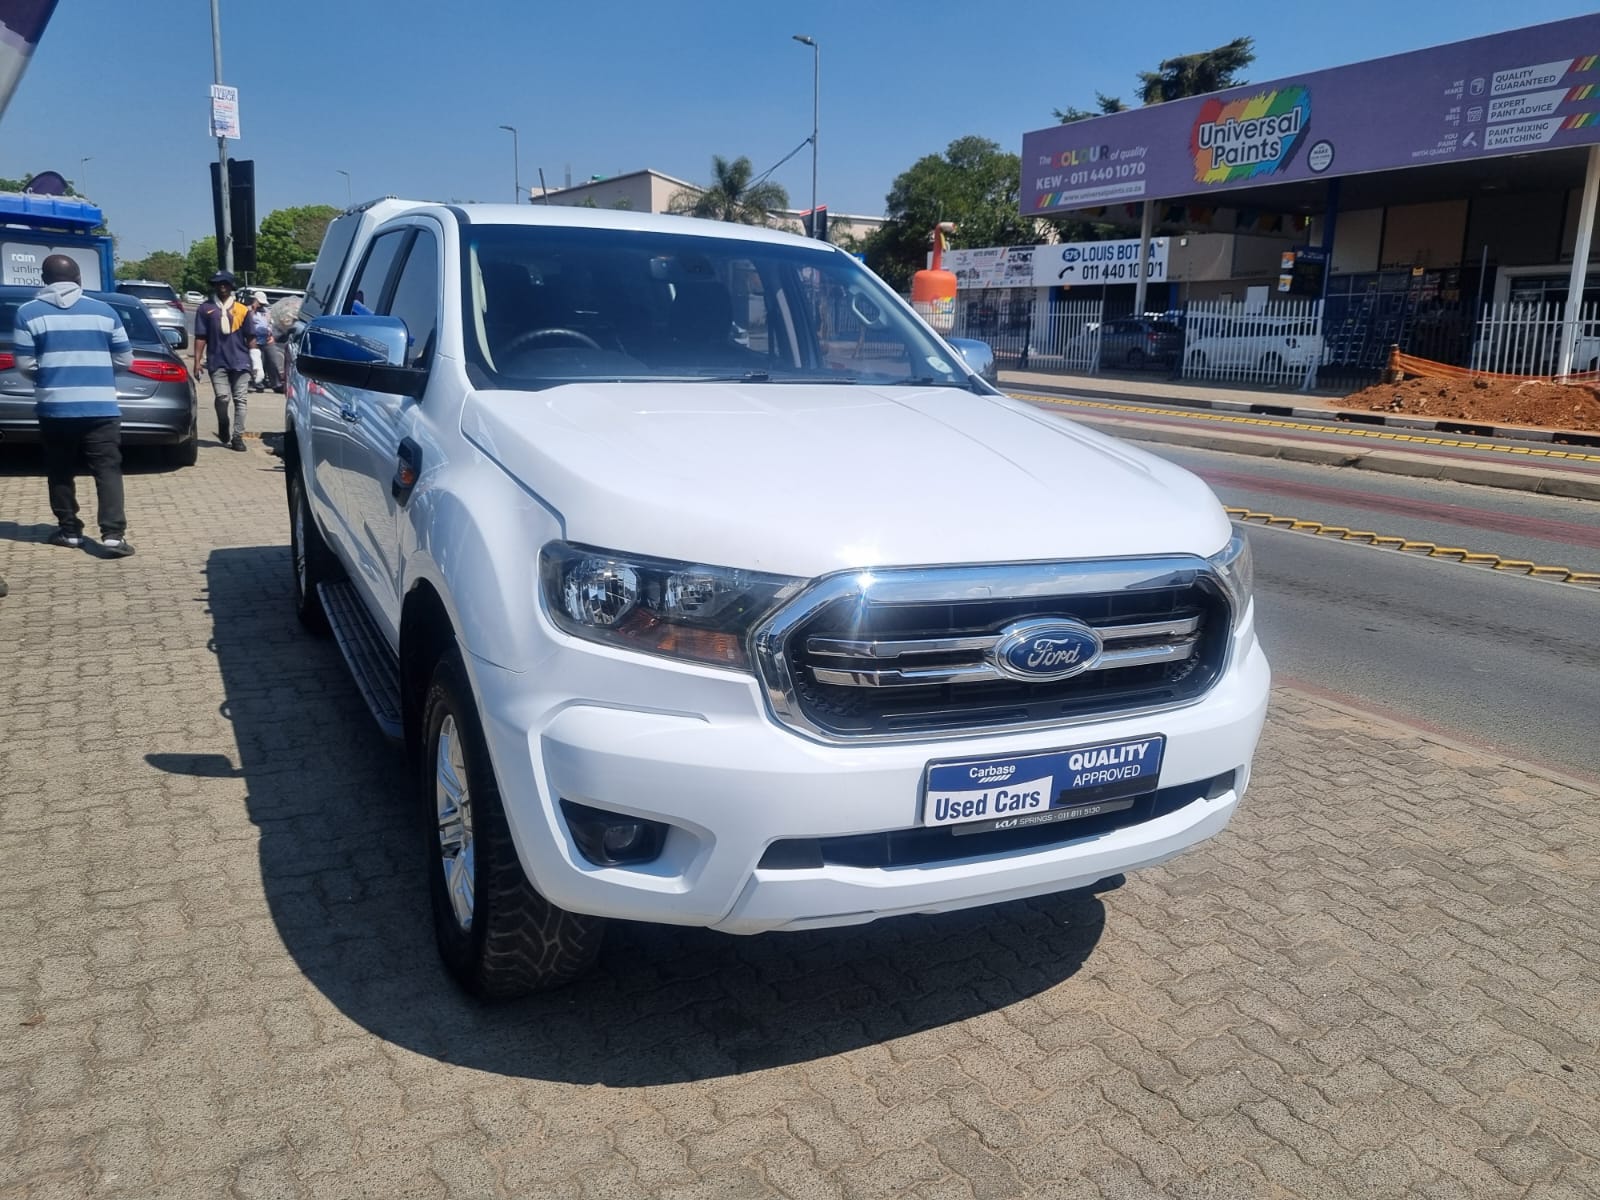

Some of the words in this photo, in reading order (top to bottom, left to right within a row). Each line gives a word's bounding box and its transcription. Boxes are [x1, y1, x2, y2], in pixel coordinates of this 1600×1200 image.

[1494, 75, 1557, 92] GUARANTEED
[1495, 70, 1534, 83] QUALITY
[1444, 87, 1464, 95] MAKE
[1490, 108, 1517, 119] PAINT
[1519, 103, 1553, 116] ADVICE
[1492, 98, 1527, 110] EXPERT
[1200, 107, 1300, 148] Universal
[1488, 127, 1515, 137] PAINT
[1516, 122, 1549, 134] MIXING
[1494, 132, 1543, 145] MATCHING
[1039, 156, 1052, 165] The
[1052, 145, 1109, 169] COLOUR
[1110, 150, 1120, 160] of
[1120, 145, 1149, 160] quality
[1213, 139, 1280, 167] Paints
[1036, 175, 1063, 190] KEW
[1070, 171, 1088, 185] 011
[1090, 166, 1113, 181] 440
[1115, 161, 1146, 177] 1070
[11, 253, 36, 263] rain
[1081, 245, 1114, 262] LOUIS
[1117, 243, 1155, 260] BOTA
[1082, 264, 1099, 280] 011
[1102, 263, 1125, 279] 440
[1027, 638, 1082, 667] Ford
[1068, 742, 1150, 771] QUALITY
[969, 765, 1016, 778] Carbase
[1072, 764, 1141, 787] APPROVED
[935, 793, 988, 821] Used
[994, 790, 1041, 813] Cars
[1019, 814, 1053, 825] SPRINGS
[1057, 811, 1069, 819] 011
[1083, 806, 1101, 815] 5130
